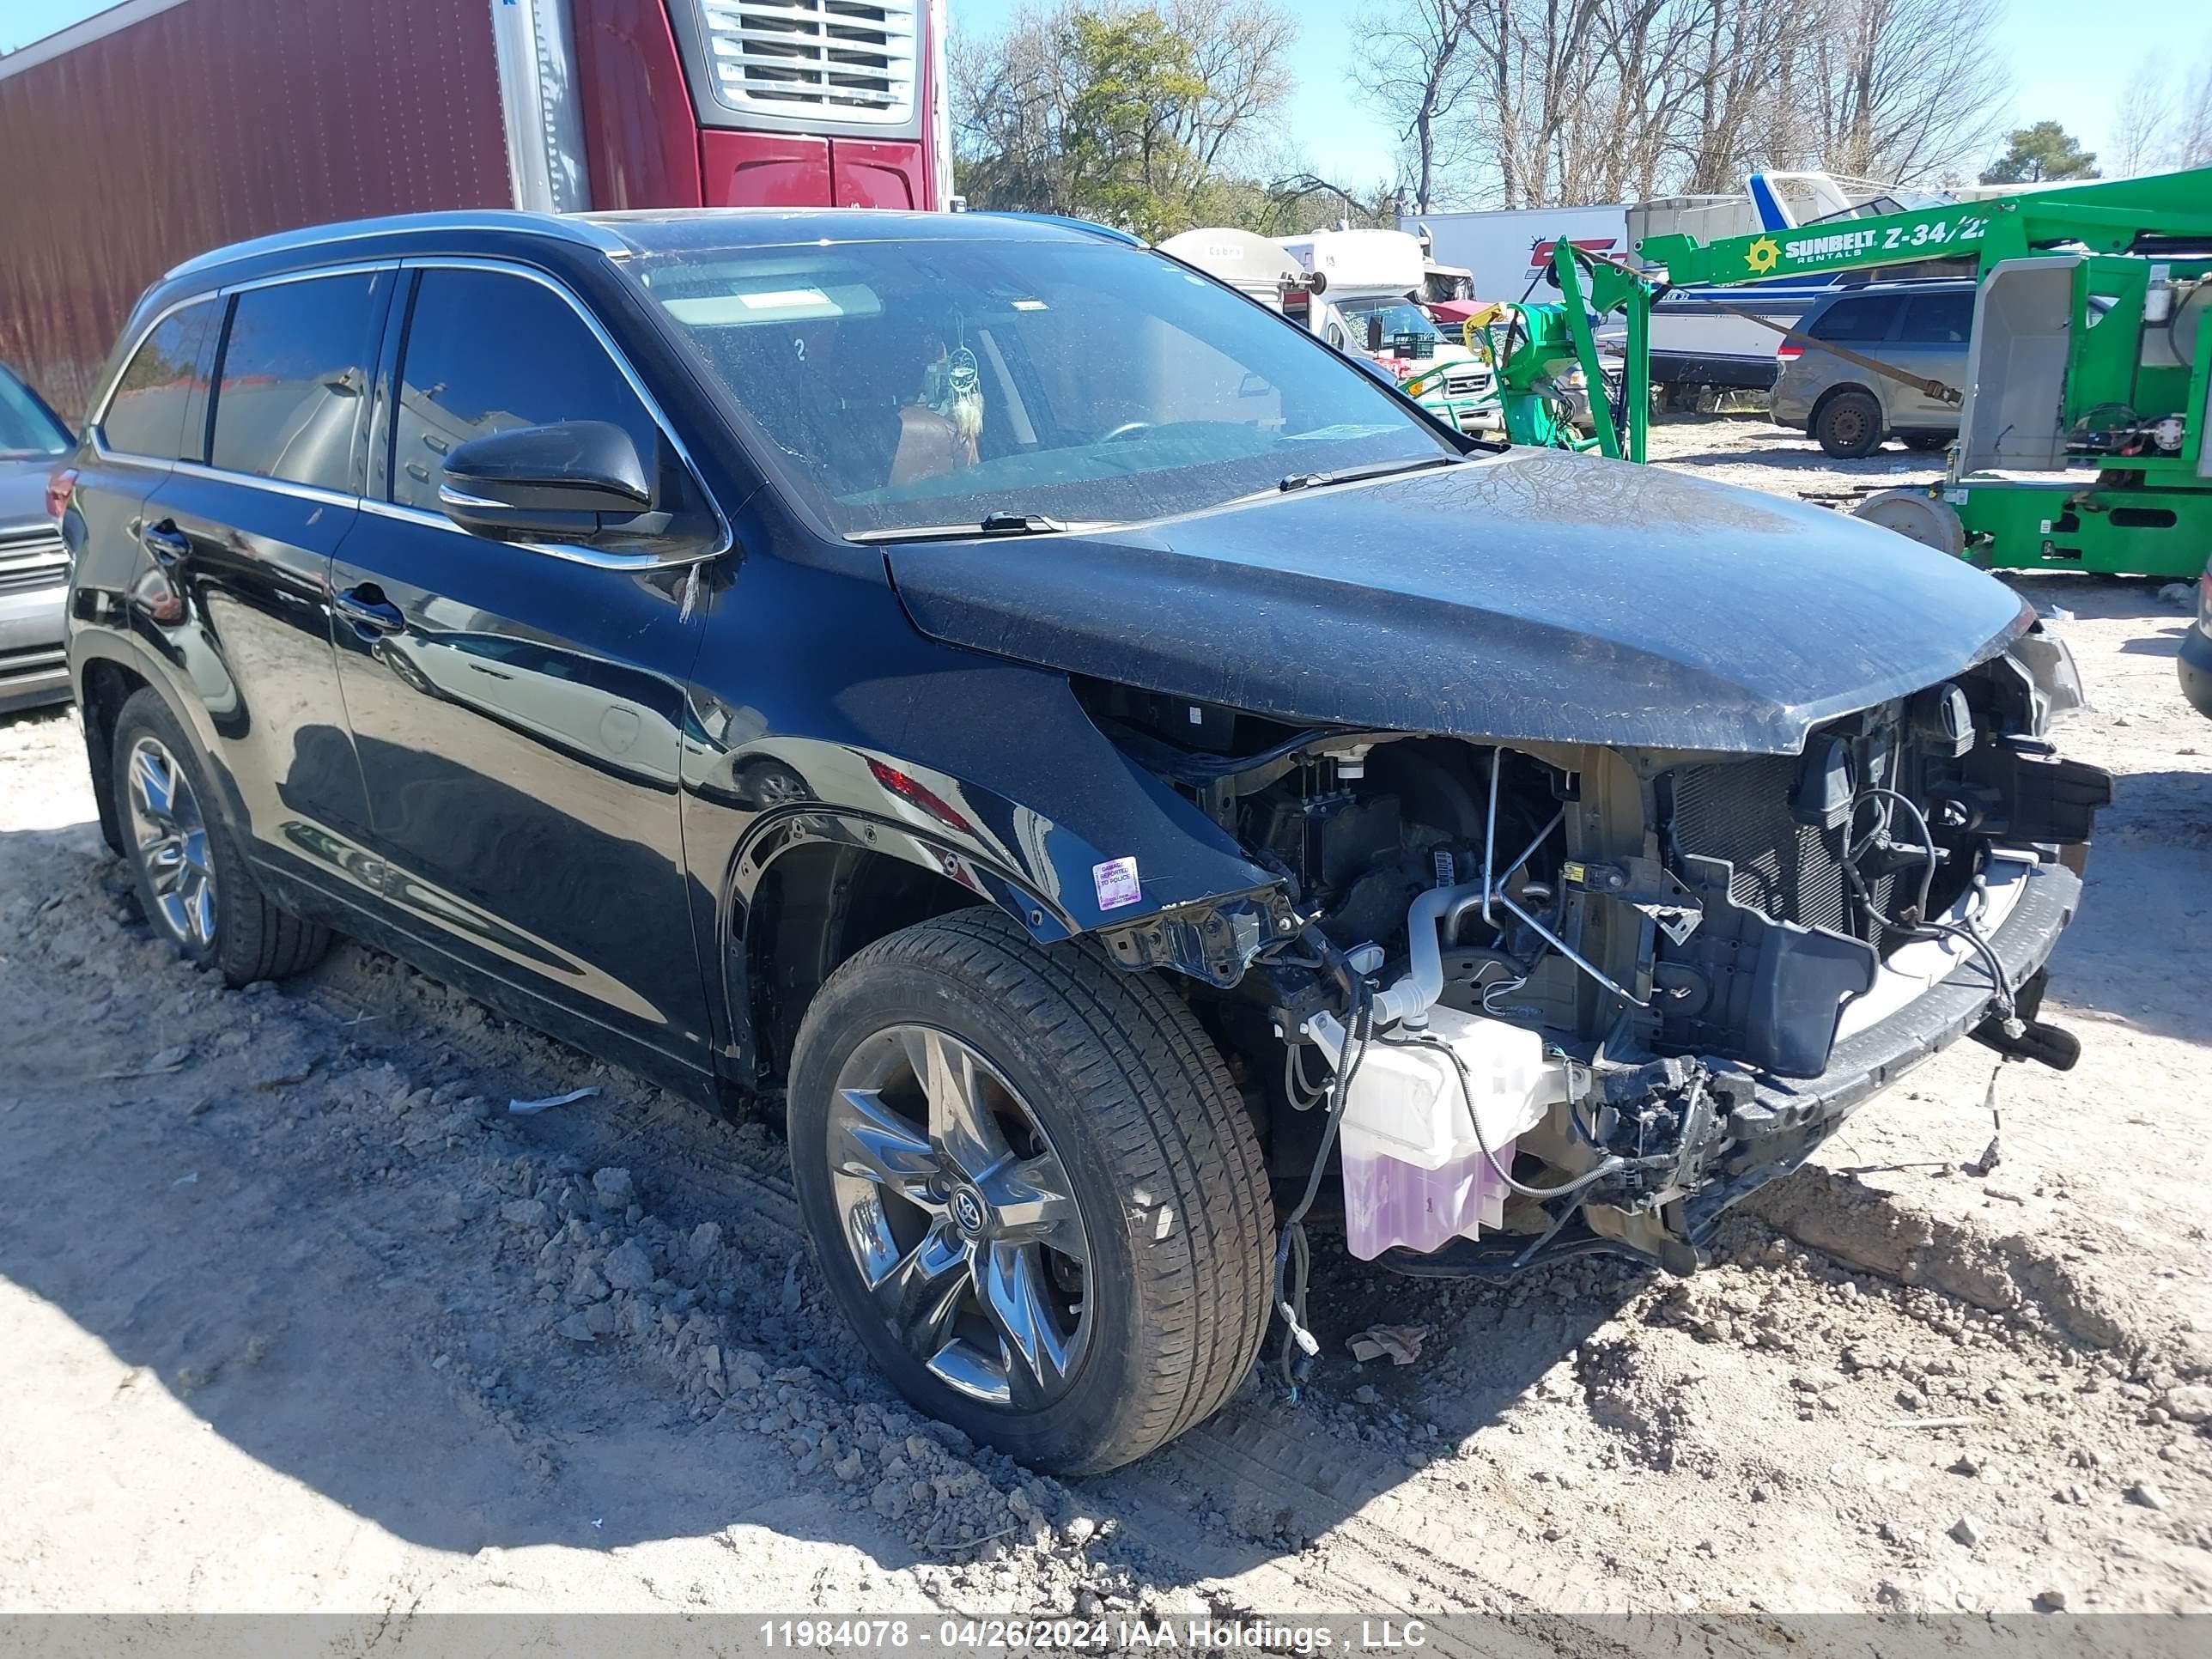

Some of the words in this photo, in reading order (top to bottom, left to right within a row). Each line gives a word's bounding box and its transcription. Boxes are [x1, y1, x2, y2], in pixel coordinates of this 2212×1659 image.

[1785, 229, 1876, 258] SUNBELT
[1797, 249, 1862, 264] RENTALS
[1100, 867, 1129, 880] REPORTED
[1110, 874, 1131, 884] POLICE
